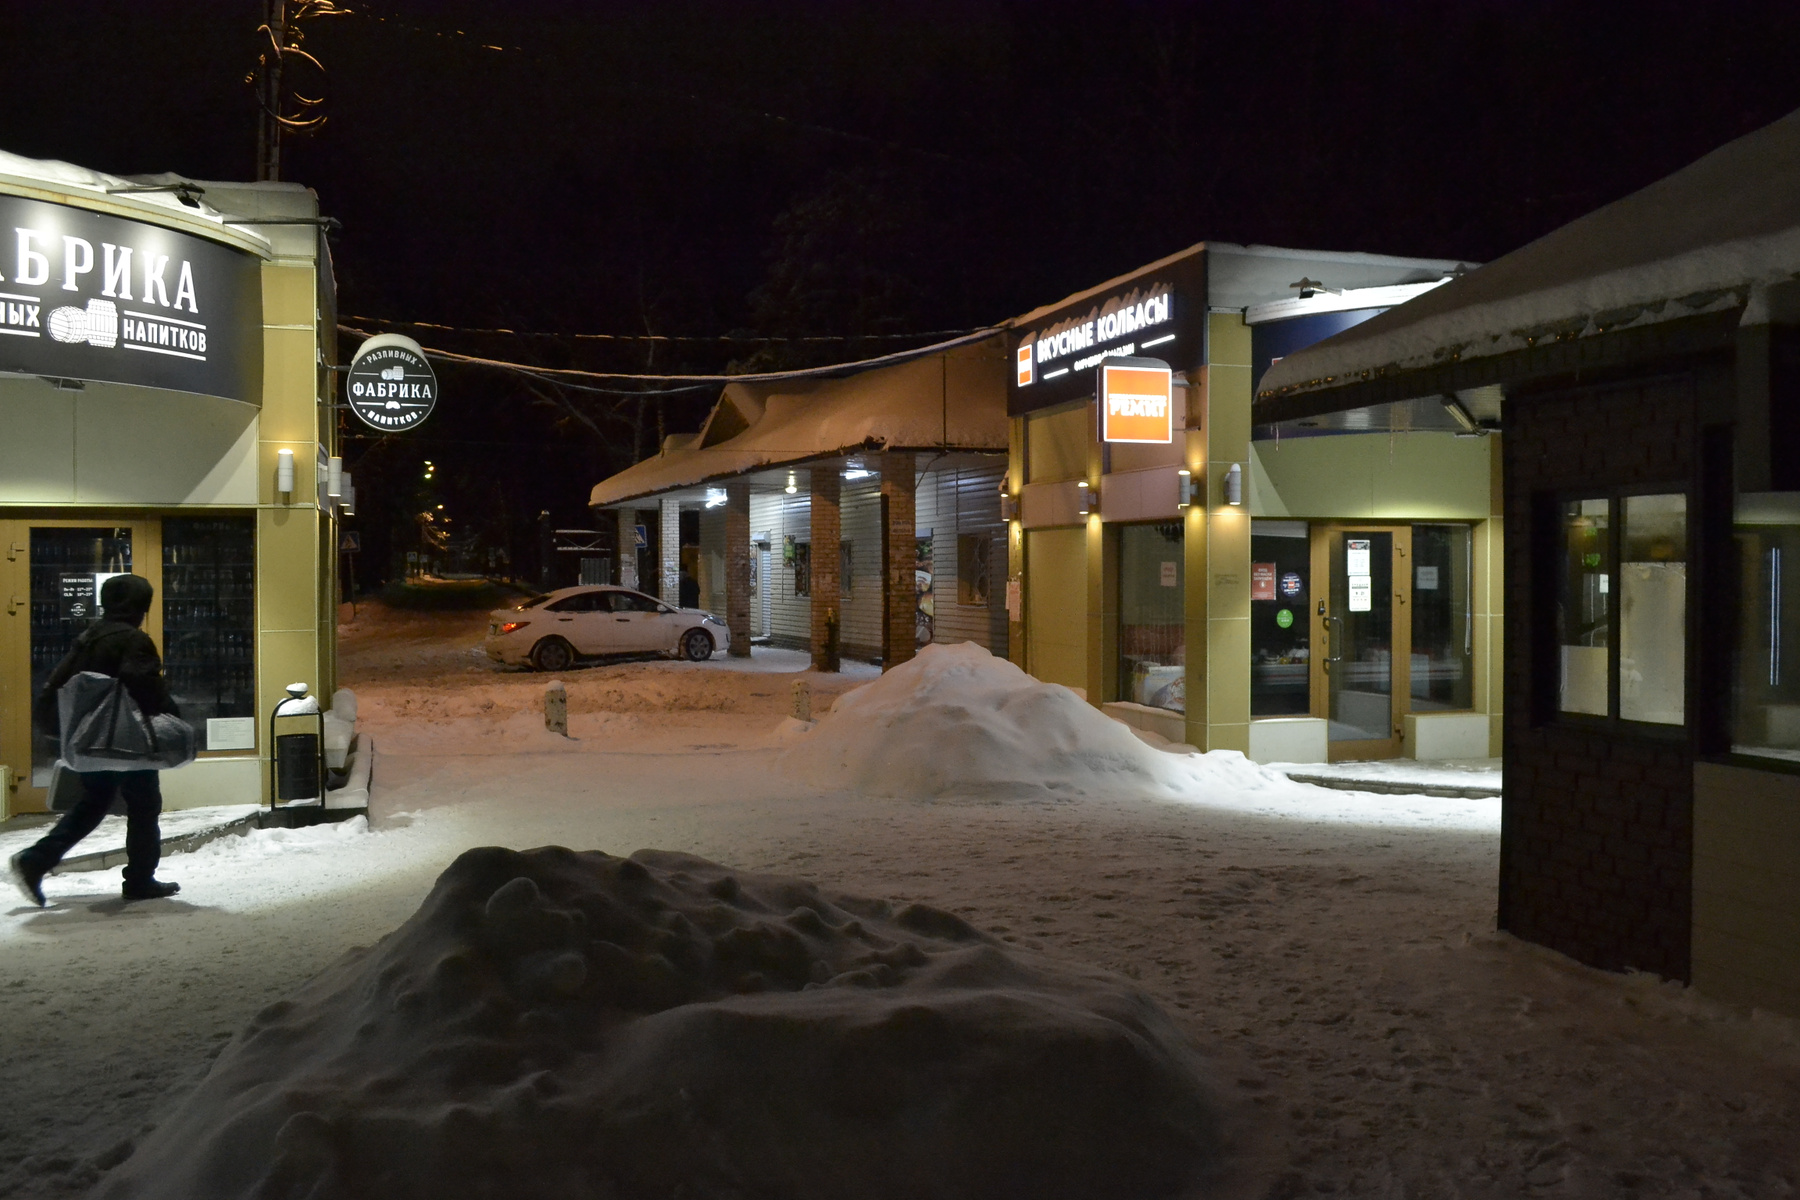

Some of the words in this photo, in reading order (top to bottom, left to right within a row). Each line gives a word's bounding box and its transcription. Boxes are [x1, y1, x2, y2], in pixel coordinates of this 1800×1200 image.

[0, 228, 199, 314] БРИКА
[123, 318, 207, 353] НАПИТКОВ
[1036, 321, 1094, 364] ВКУСНЫЕ
[1097, 293, 1168, 343] КОЛБАСЫ
[366, 350, 418, 365] РАЗЛИВНЫХ
[352, 381, 432, 398] ФАБРИКА
[367, 410, 418, 425] НАПИТКОВ
